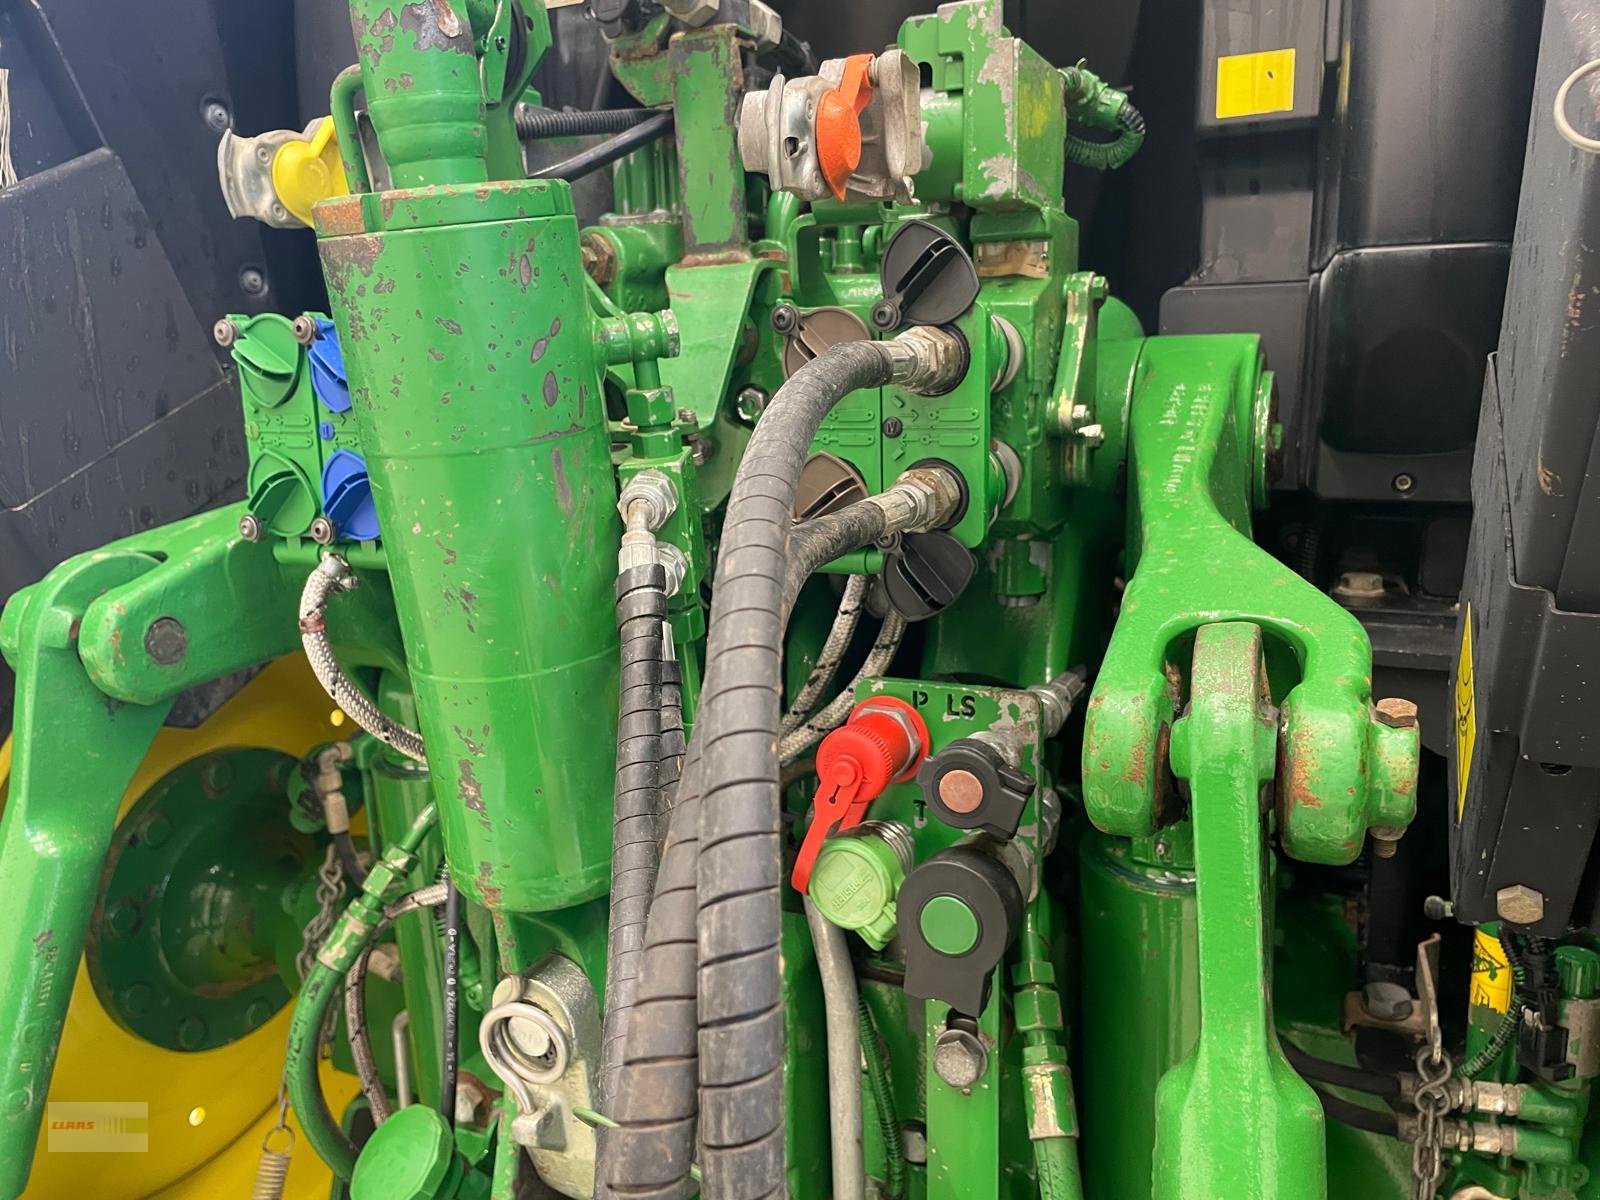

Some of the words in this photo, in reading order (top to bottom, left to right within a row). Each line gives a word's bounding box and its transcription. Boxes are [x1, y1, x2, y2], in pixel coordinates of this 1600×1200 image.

[912, 690, 928, 710] P
[946, 693, 976, 718] LS
[913, 800, 927, 821] T
